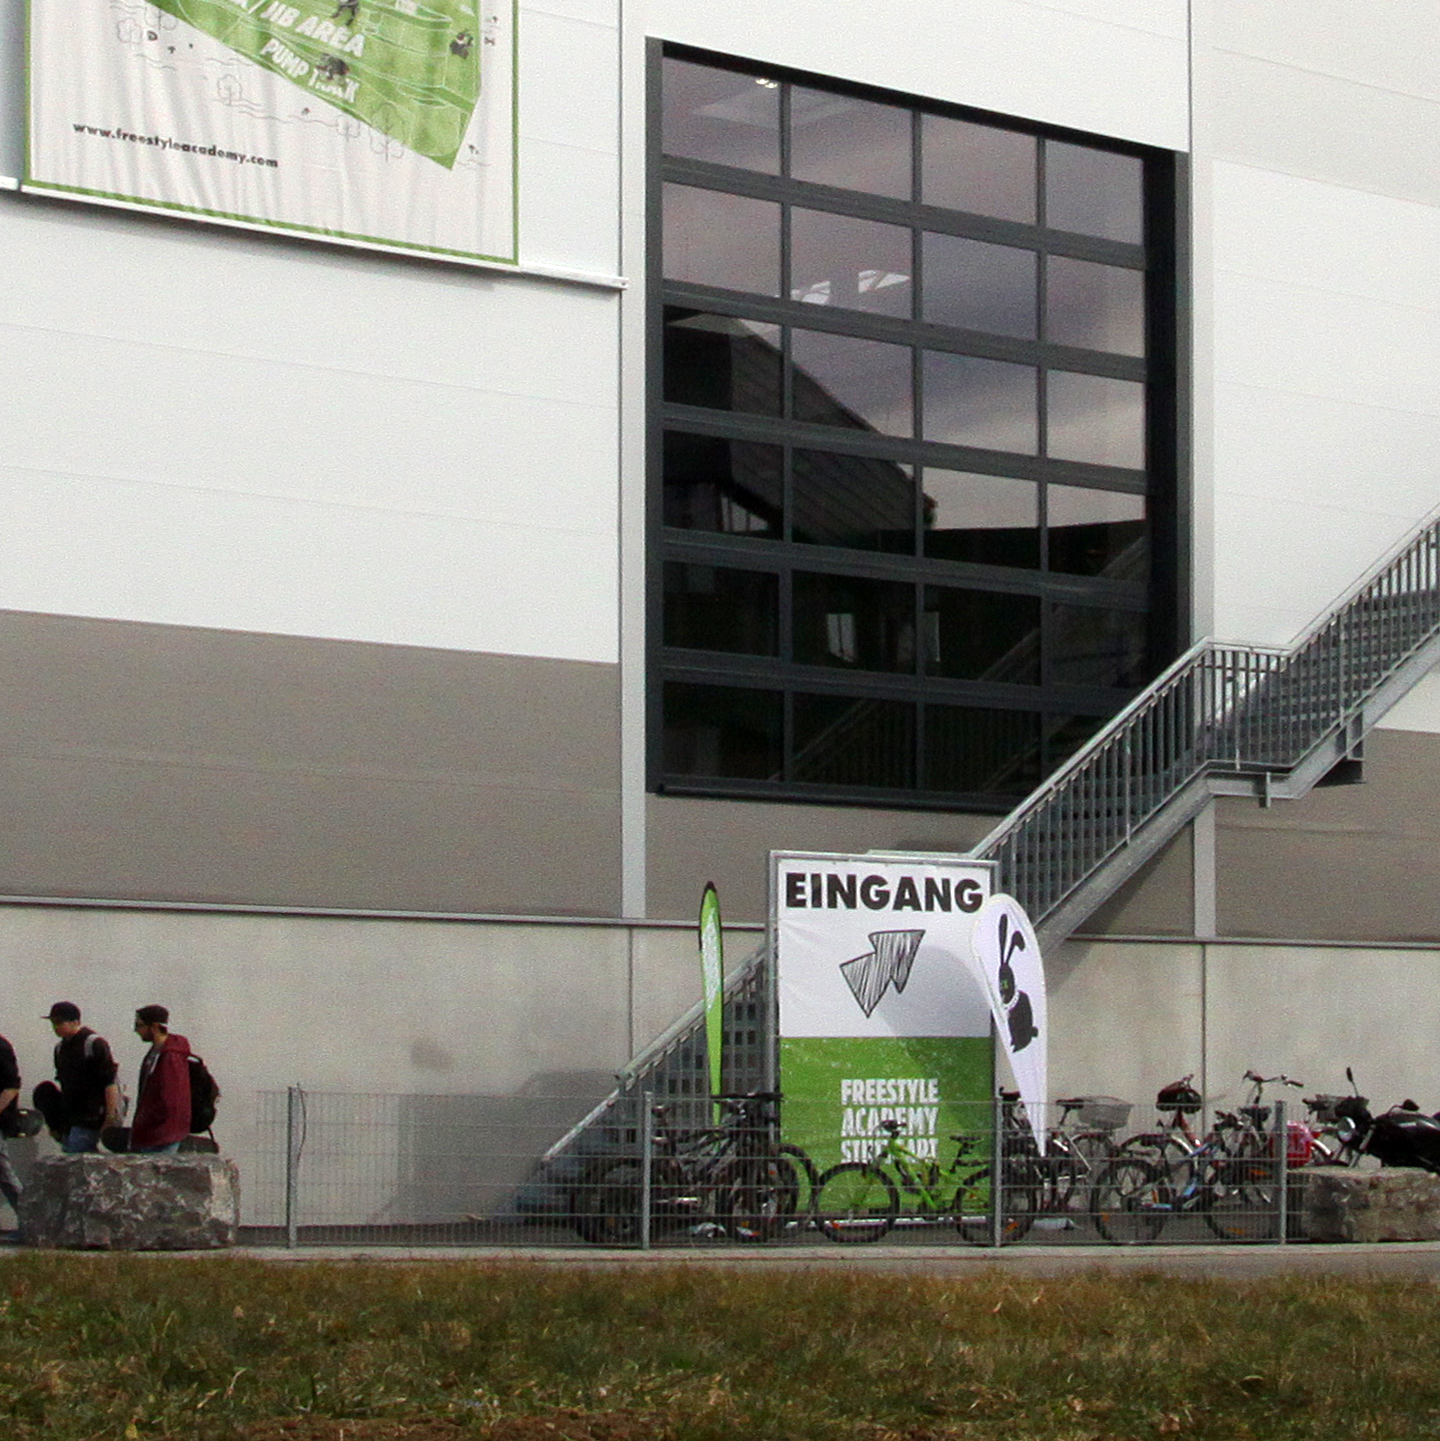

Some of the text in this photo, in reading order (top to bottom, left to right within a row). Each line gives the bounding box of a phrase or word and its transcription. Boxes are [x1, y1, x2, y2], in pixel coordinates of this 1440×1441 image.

[260, 0, 301, 28] JIB
[295, 16, 367, 57] AREA
[259, 38, 310, 78] PUMP
[72, 122, 279, 168] www.freestyleacademy.com
[785, 872, 983, 913] EINGANG
[840, 1078, 940, 1105] FREESTYLE
